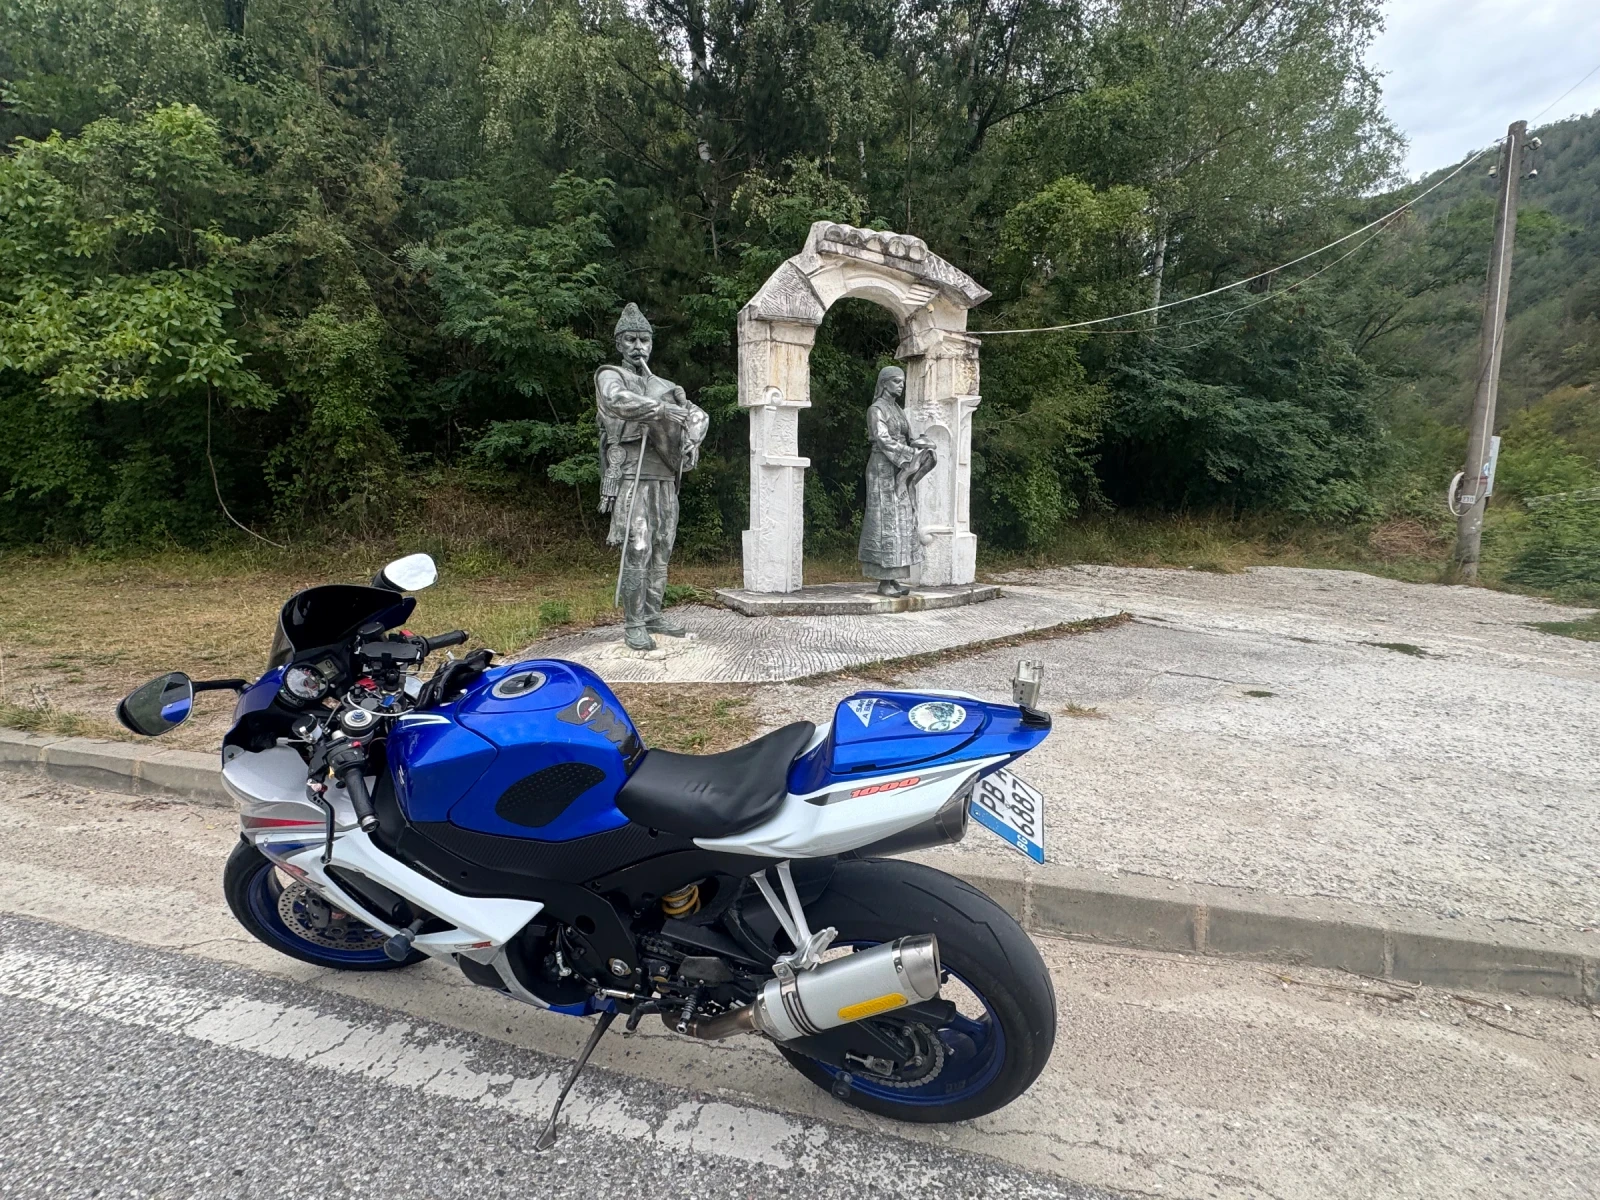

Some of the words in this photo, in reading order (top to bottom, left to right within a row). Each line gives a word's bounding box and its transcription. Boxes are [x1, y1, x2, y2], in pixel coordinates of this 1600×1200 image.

[850, 776, 921, 798] 1000
[980, 779, 1005, 819] PB
[1010, 778, 1036, 837] 6887
[1016, 834, 1029, 853] BG
